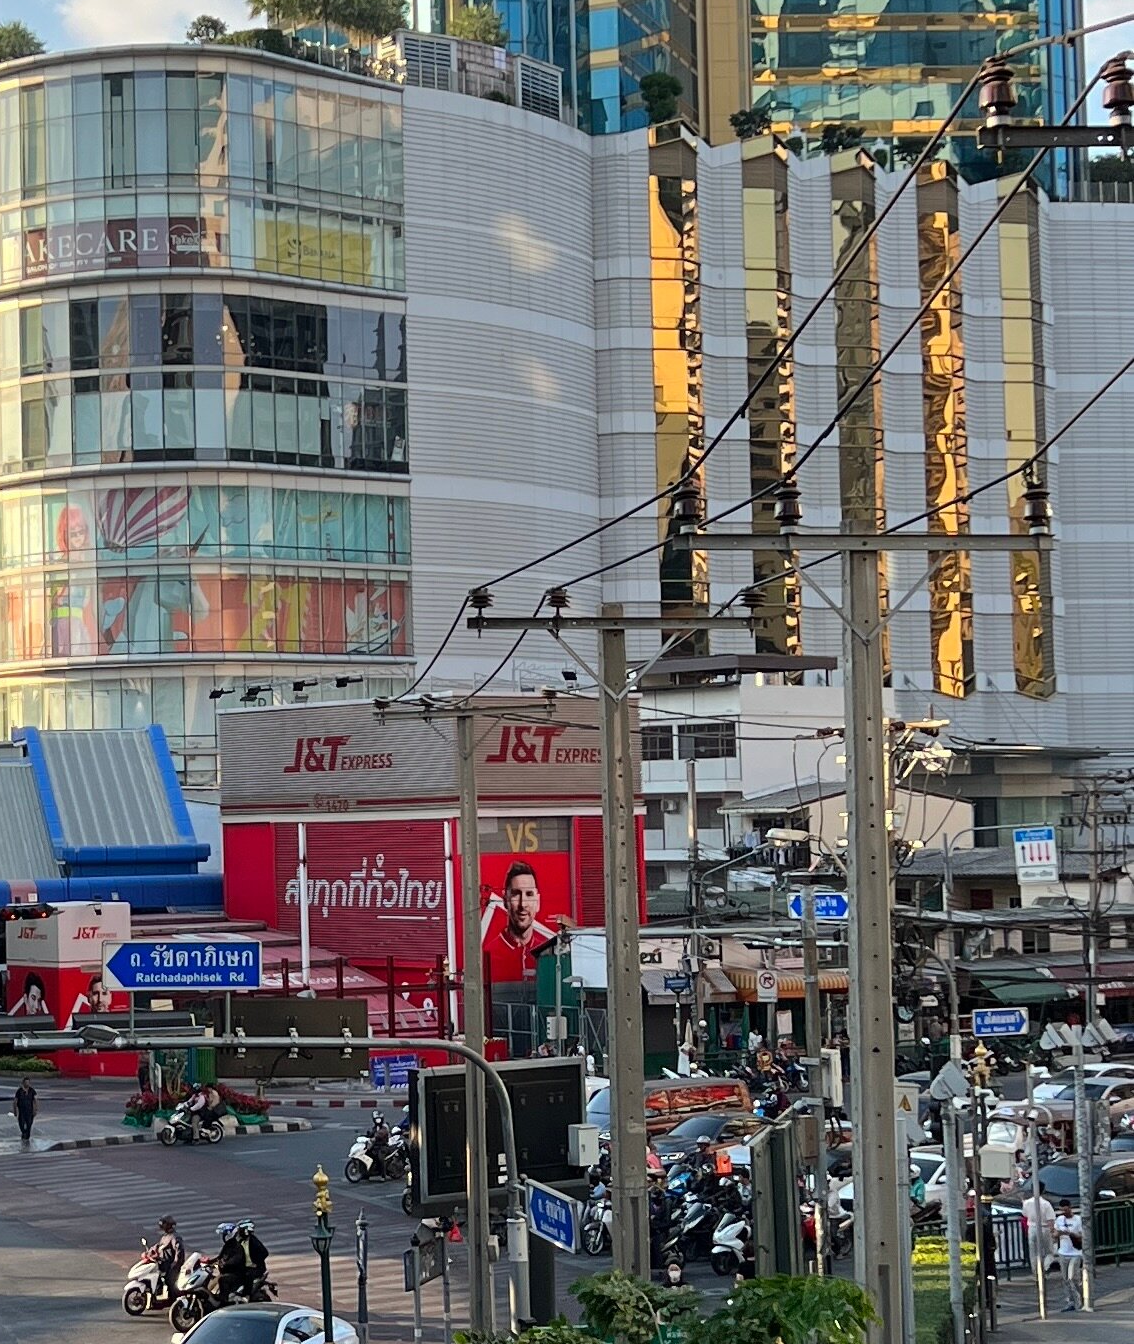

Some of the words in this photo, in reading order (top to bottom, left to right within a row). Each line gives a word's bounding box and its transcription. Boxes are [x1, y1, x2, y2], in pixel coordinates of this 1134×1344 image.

[284, 735, 352, 773] J&T
[341, 753, 393, 771] EXPRESS
[485, 725, 567, 764] J&T
[72, 926, 100, 940] J&T
[150, 944, 254, 967] รัชดาภิเษก
[135, 972, 223, 984] Ratchadaphisek
[229, 972, 248, 982] Rd.
